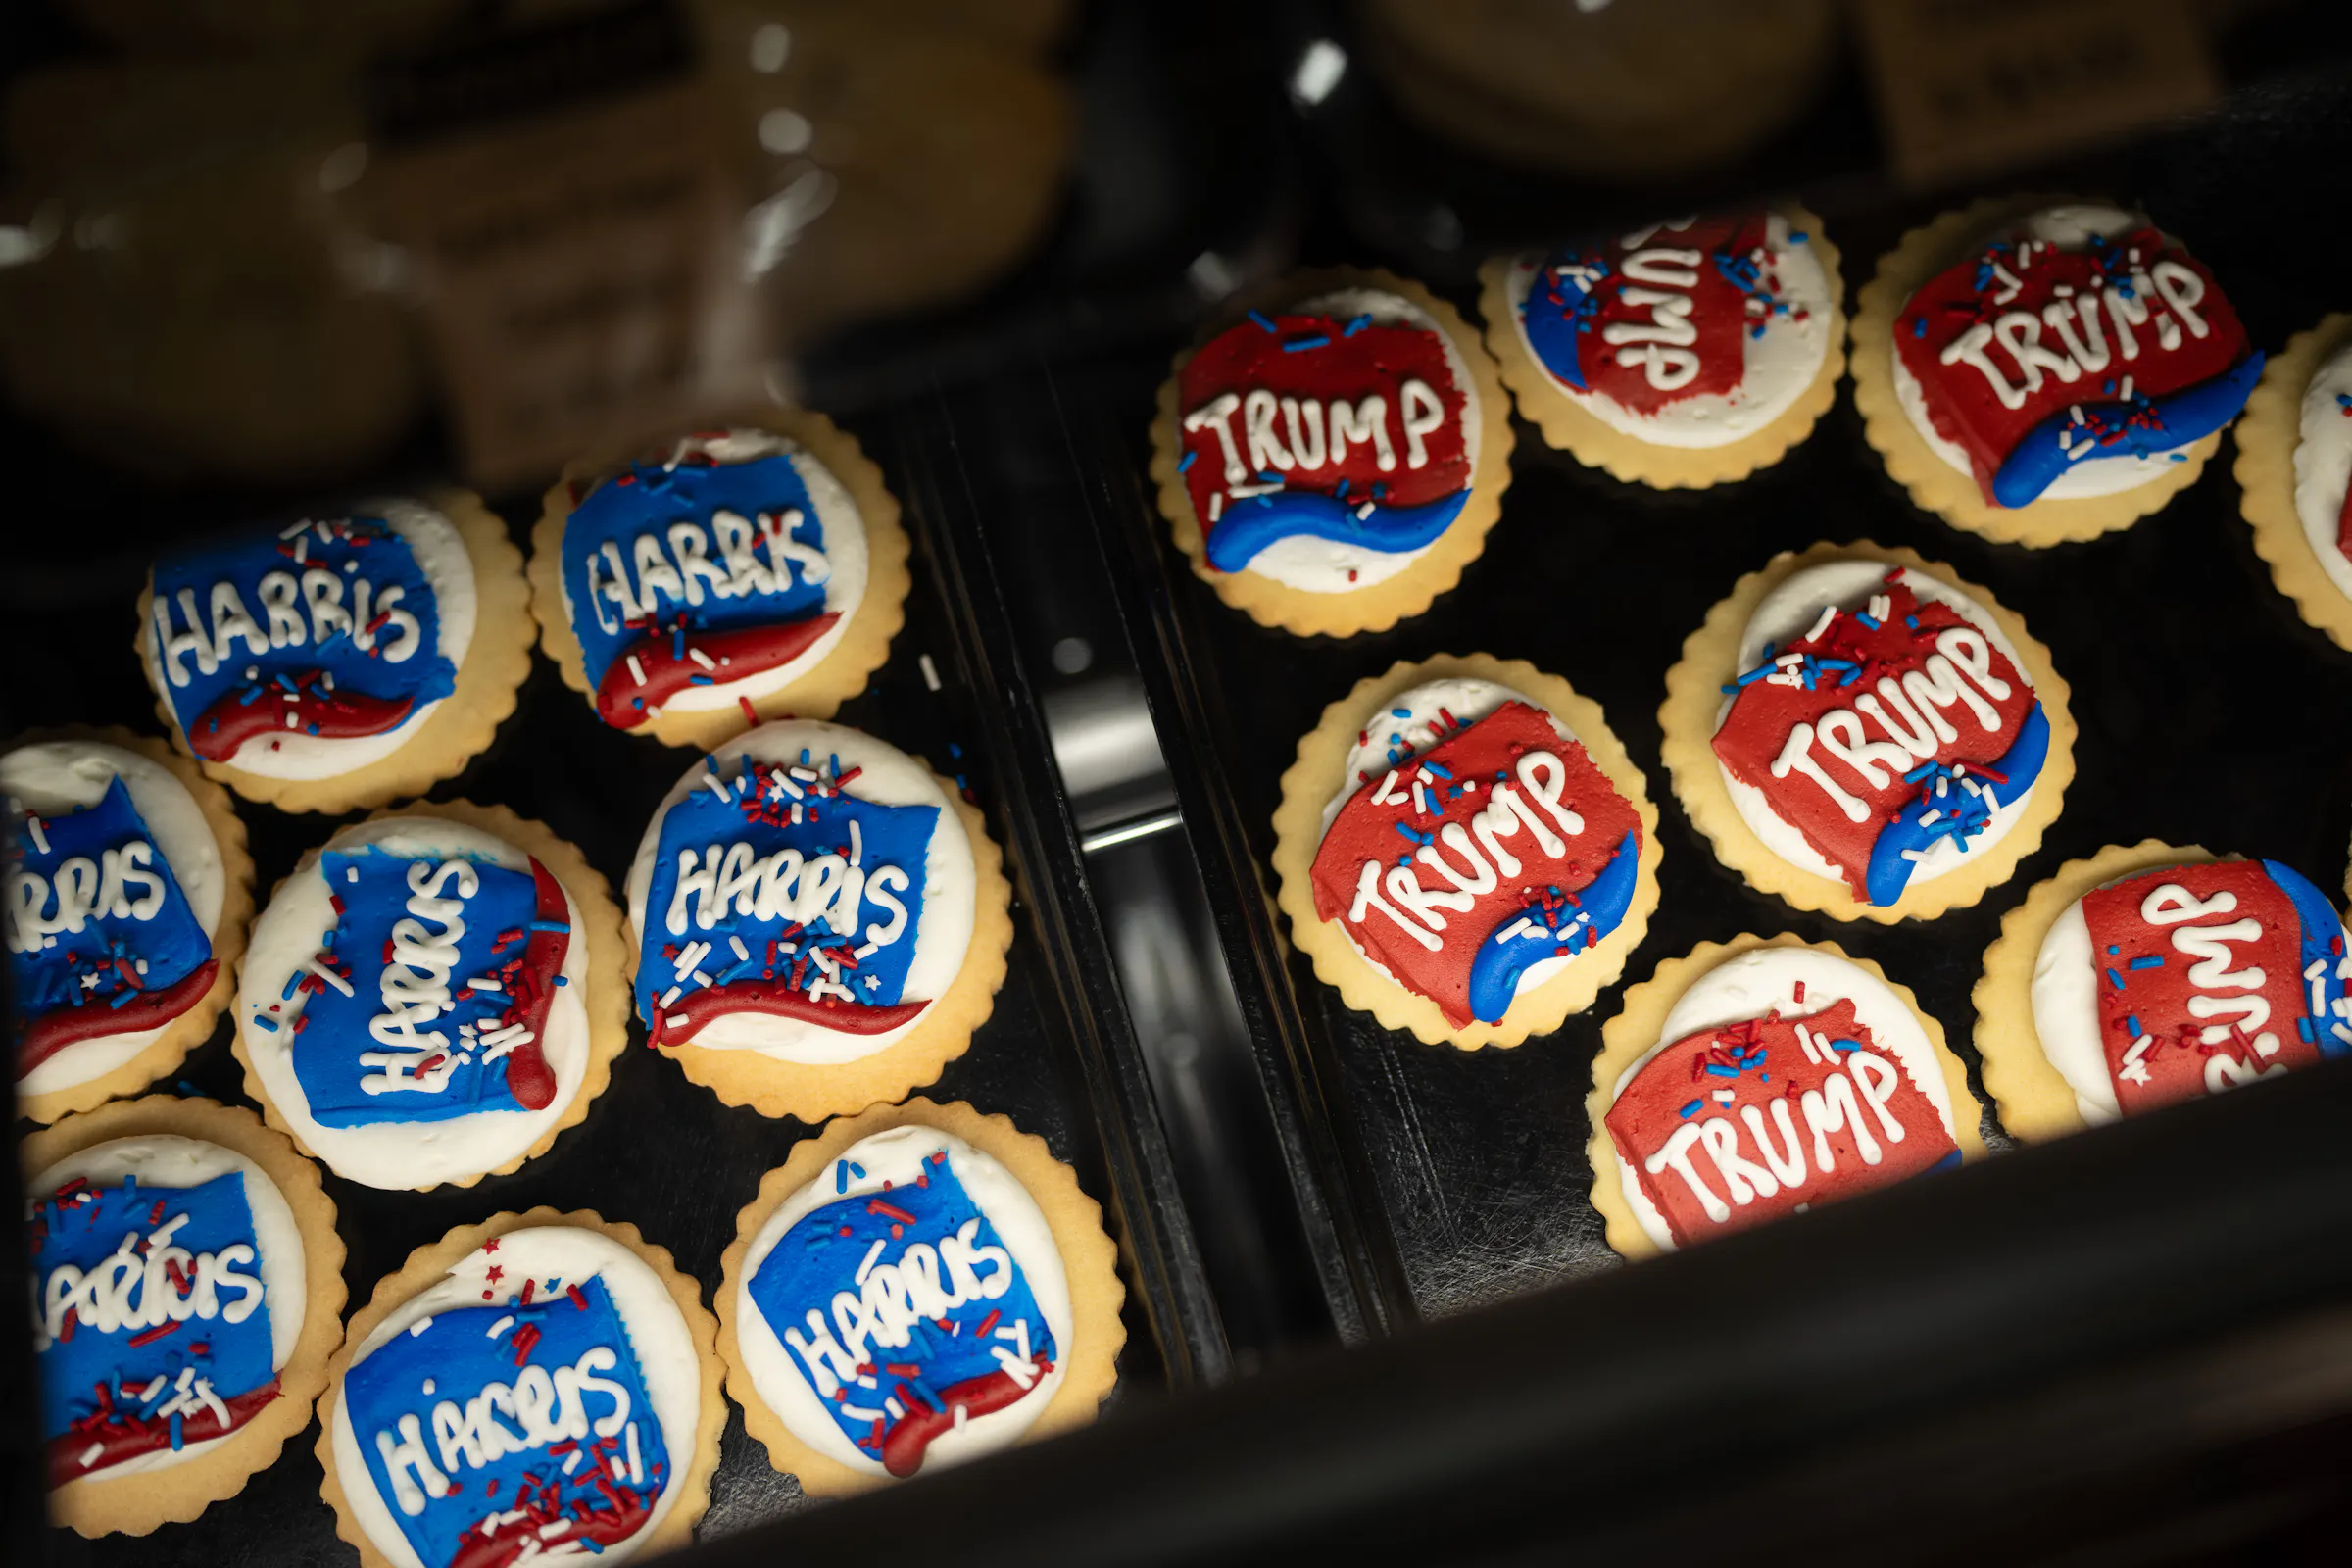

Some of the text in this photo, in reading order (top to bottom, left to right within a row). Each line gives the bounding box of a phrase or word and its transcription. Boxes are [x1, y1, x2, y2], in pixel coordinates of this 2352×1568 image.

[1939, 260, 2209, 410] TRUMP
[1184, 378, 1445, 482] TRUMP
[152, 567, 421, 687] HARRIS
[586, 508, 830, 636] HARRIS
[1770, 627, 2011, 823] TRUMP
[6, 840, 166, 954] RRIS
[666, 841, 909, 946] HARRIS
[1348, 750, 1585, 951] TRUMP
[359, 859, 479, 1095] HARRIS
[1645, 1050, 1905, 1223] TRUMP
[784, 1217, 1012, 1398] HARRIS
[376, 1347, 630, 1516] HARRIS
